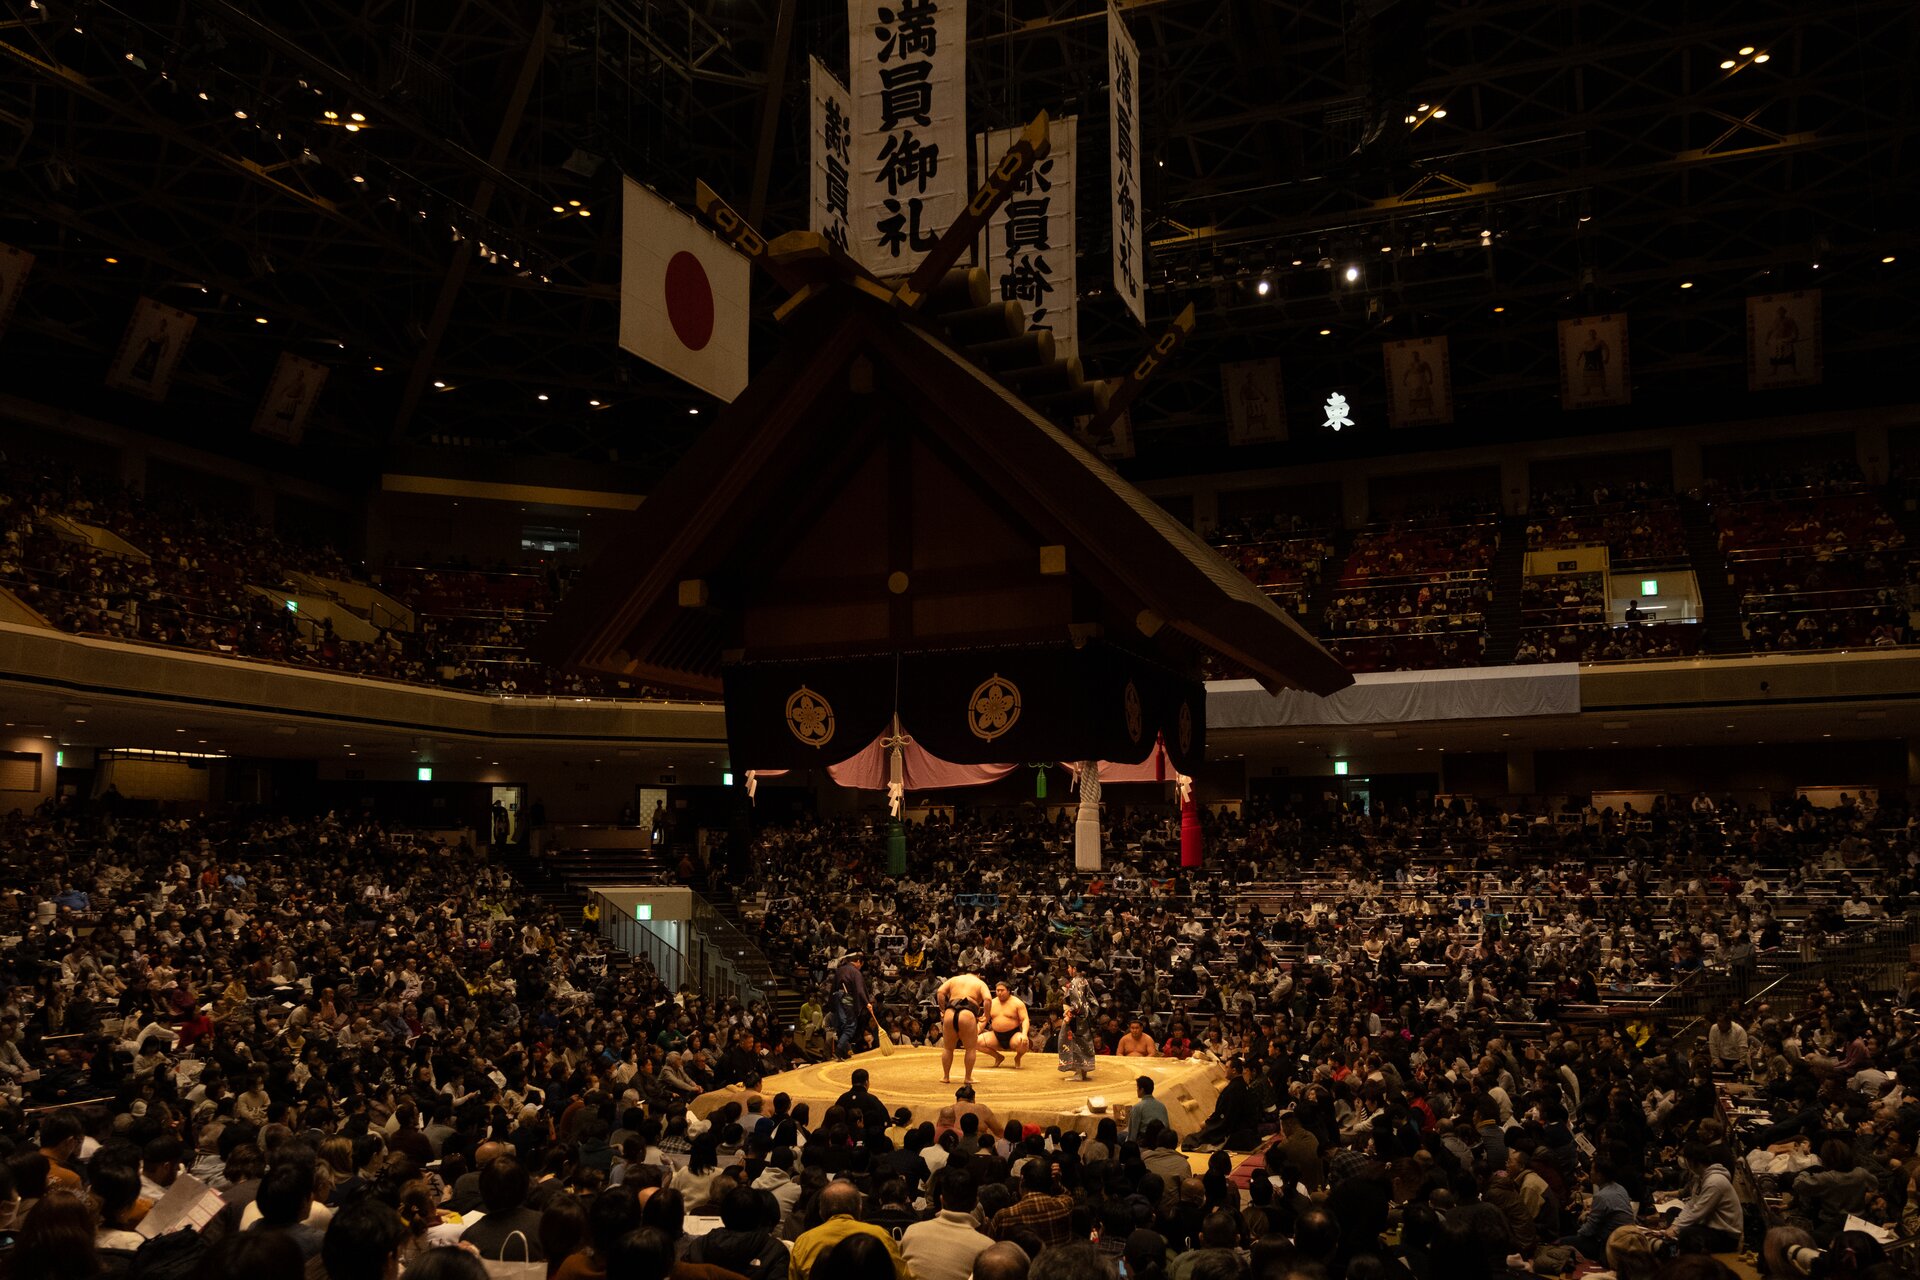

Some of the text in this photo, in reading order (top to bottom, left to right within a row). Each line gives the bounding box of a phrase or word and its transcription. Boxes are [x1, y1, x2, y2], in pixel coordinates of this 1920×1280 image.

[875, 0, 939, 258] 満員御礼
[1114, 37, 1137, 298] 満員御礼
[1320, 391, 1355, 431] 東
